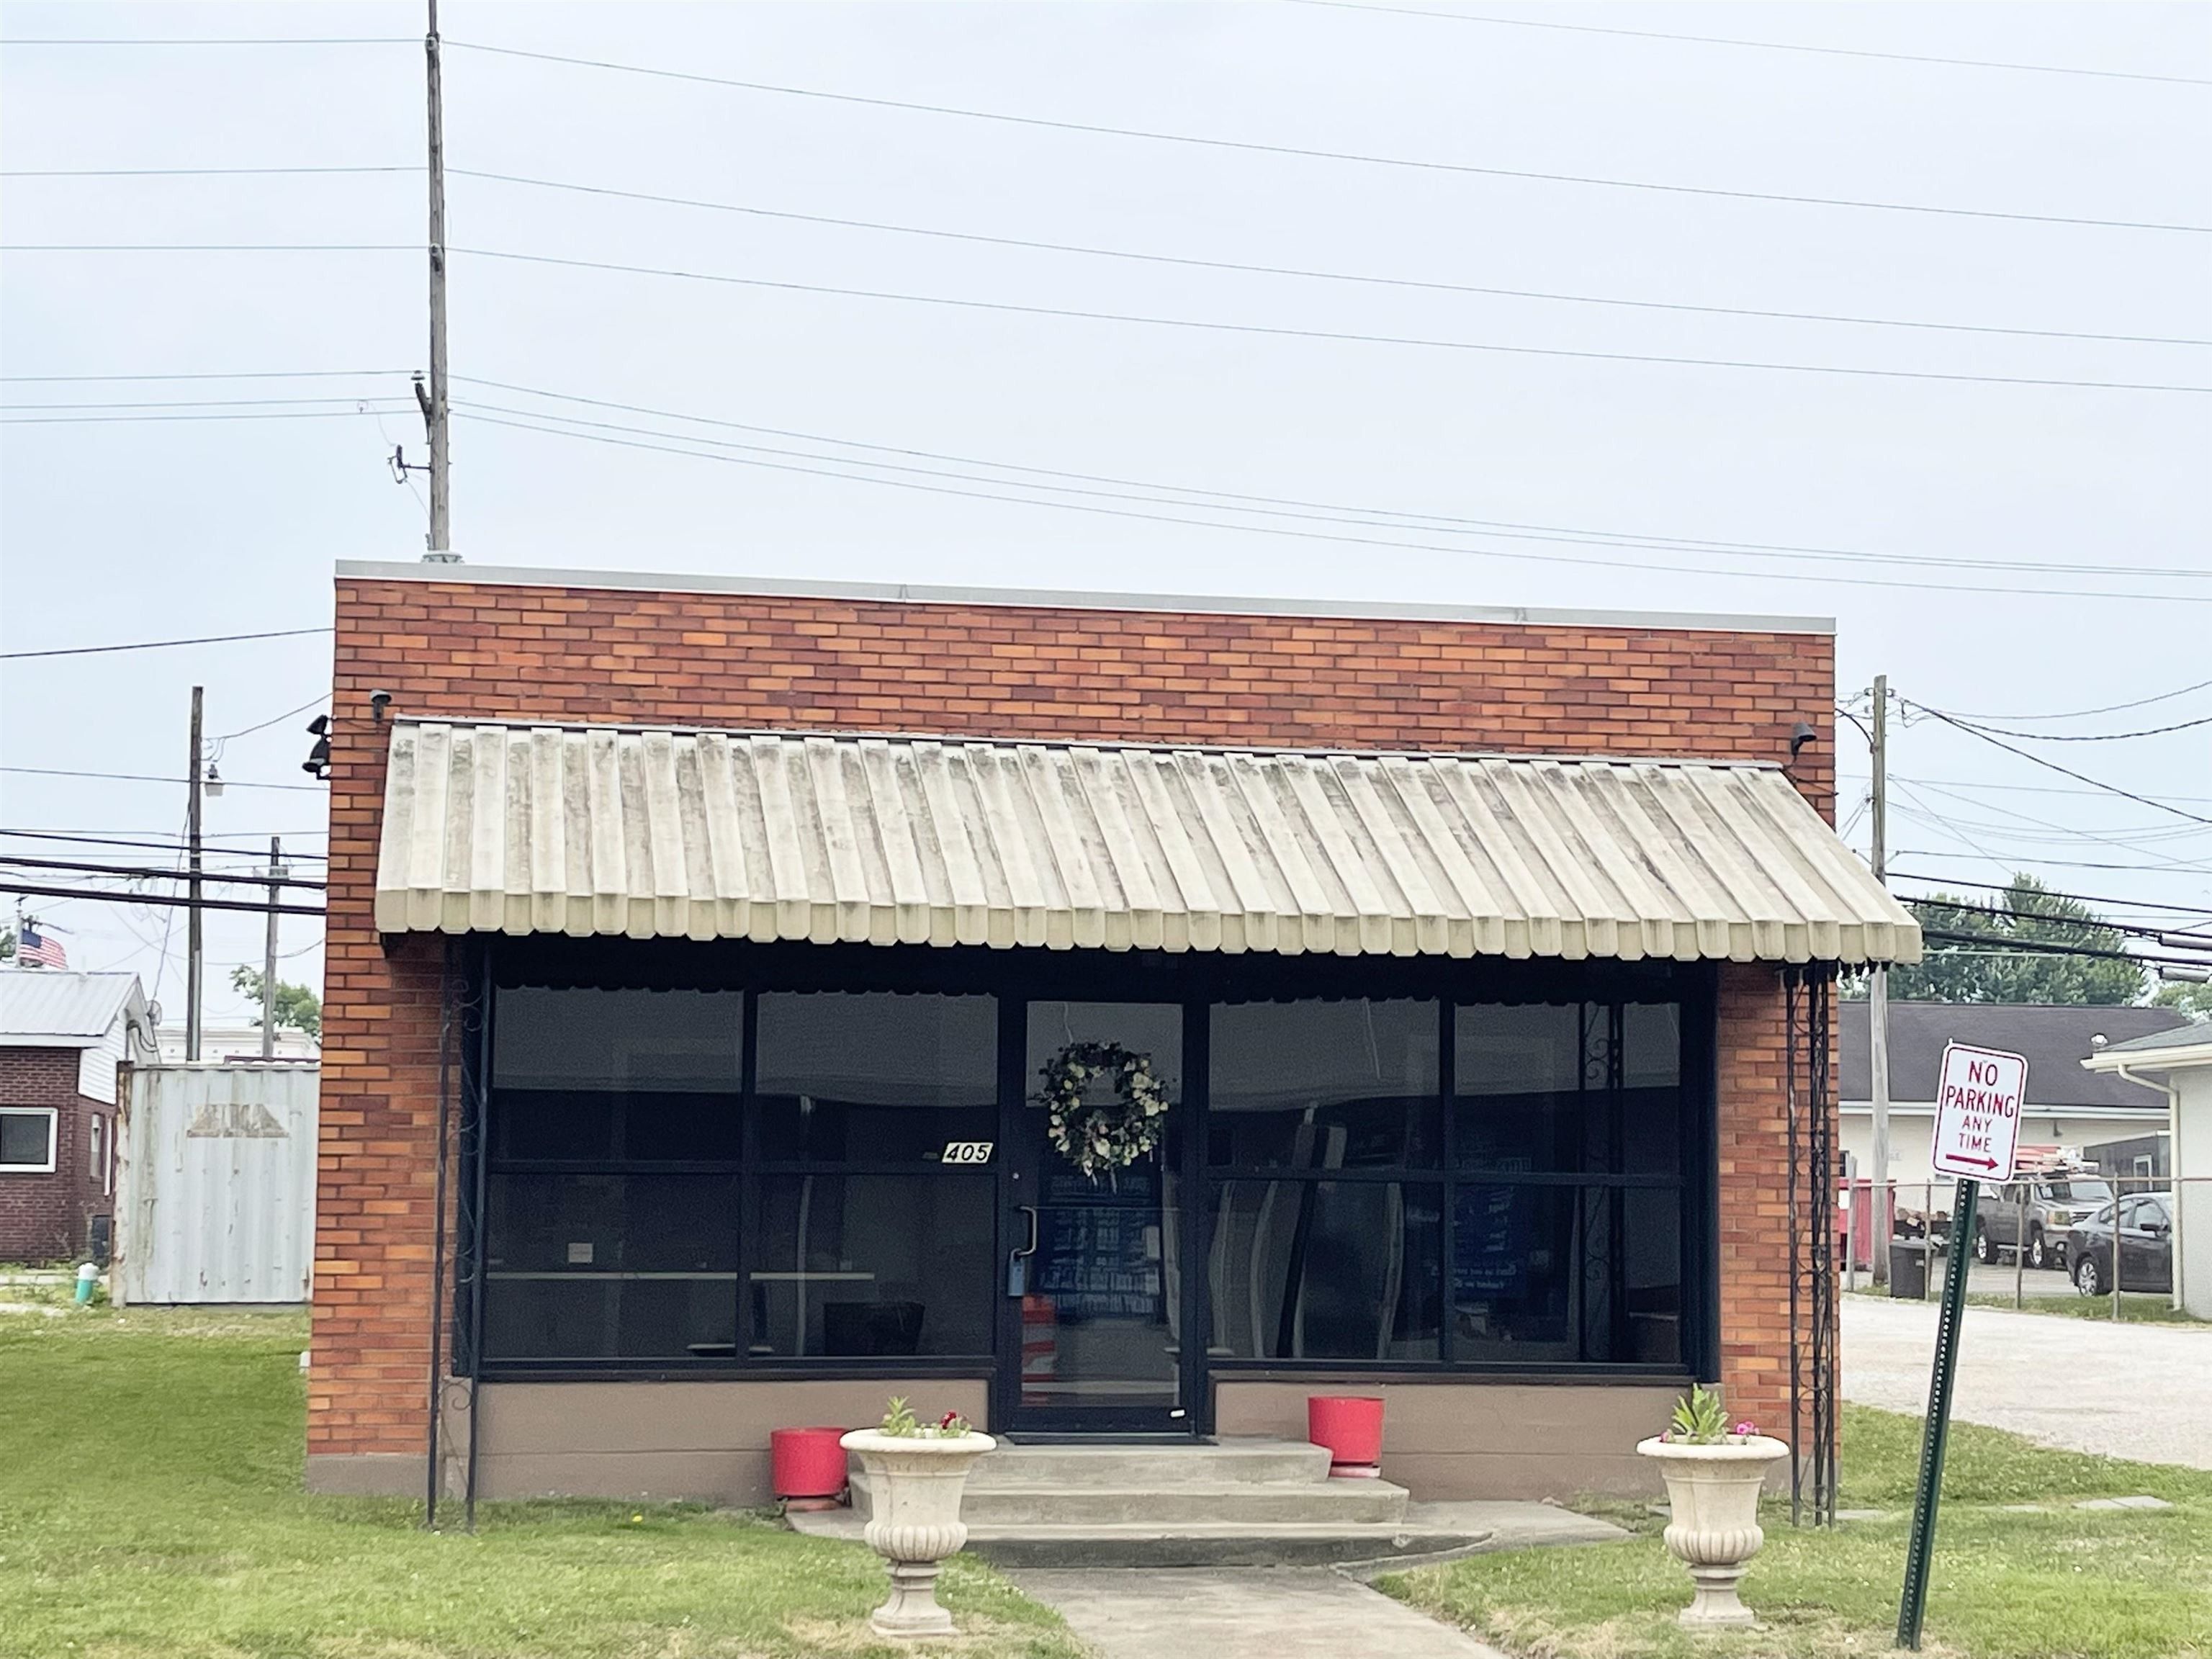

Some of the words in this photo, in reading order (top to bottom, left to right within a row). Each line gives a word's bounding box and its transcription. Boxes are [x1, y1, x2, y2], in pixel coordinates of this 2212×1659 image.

[1968, 1060, 1998, 1087] NO
[1946, 1085, 2015, 1118] PARKING
[1961, 1115, 1993, 1133] ANY
[946, 1144, 990, 1161] 405
[1959, 1132, 1992, 1153] TIME
